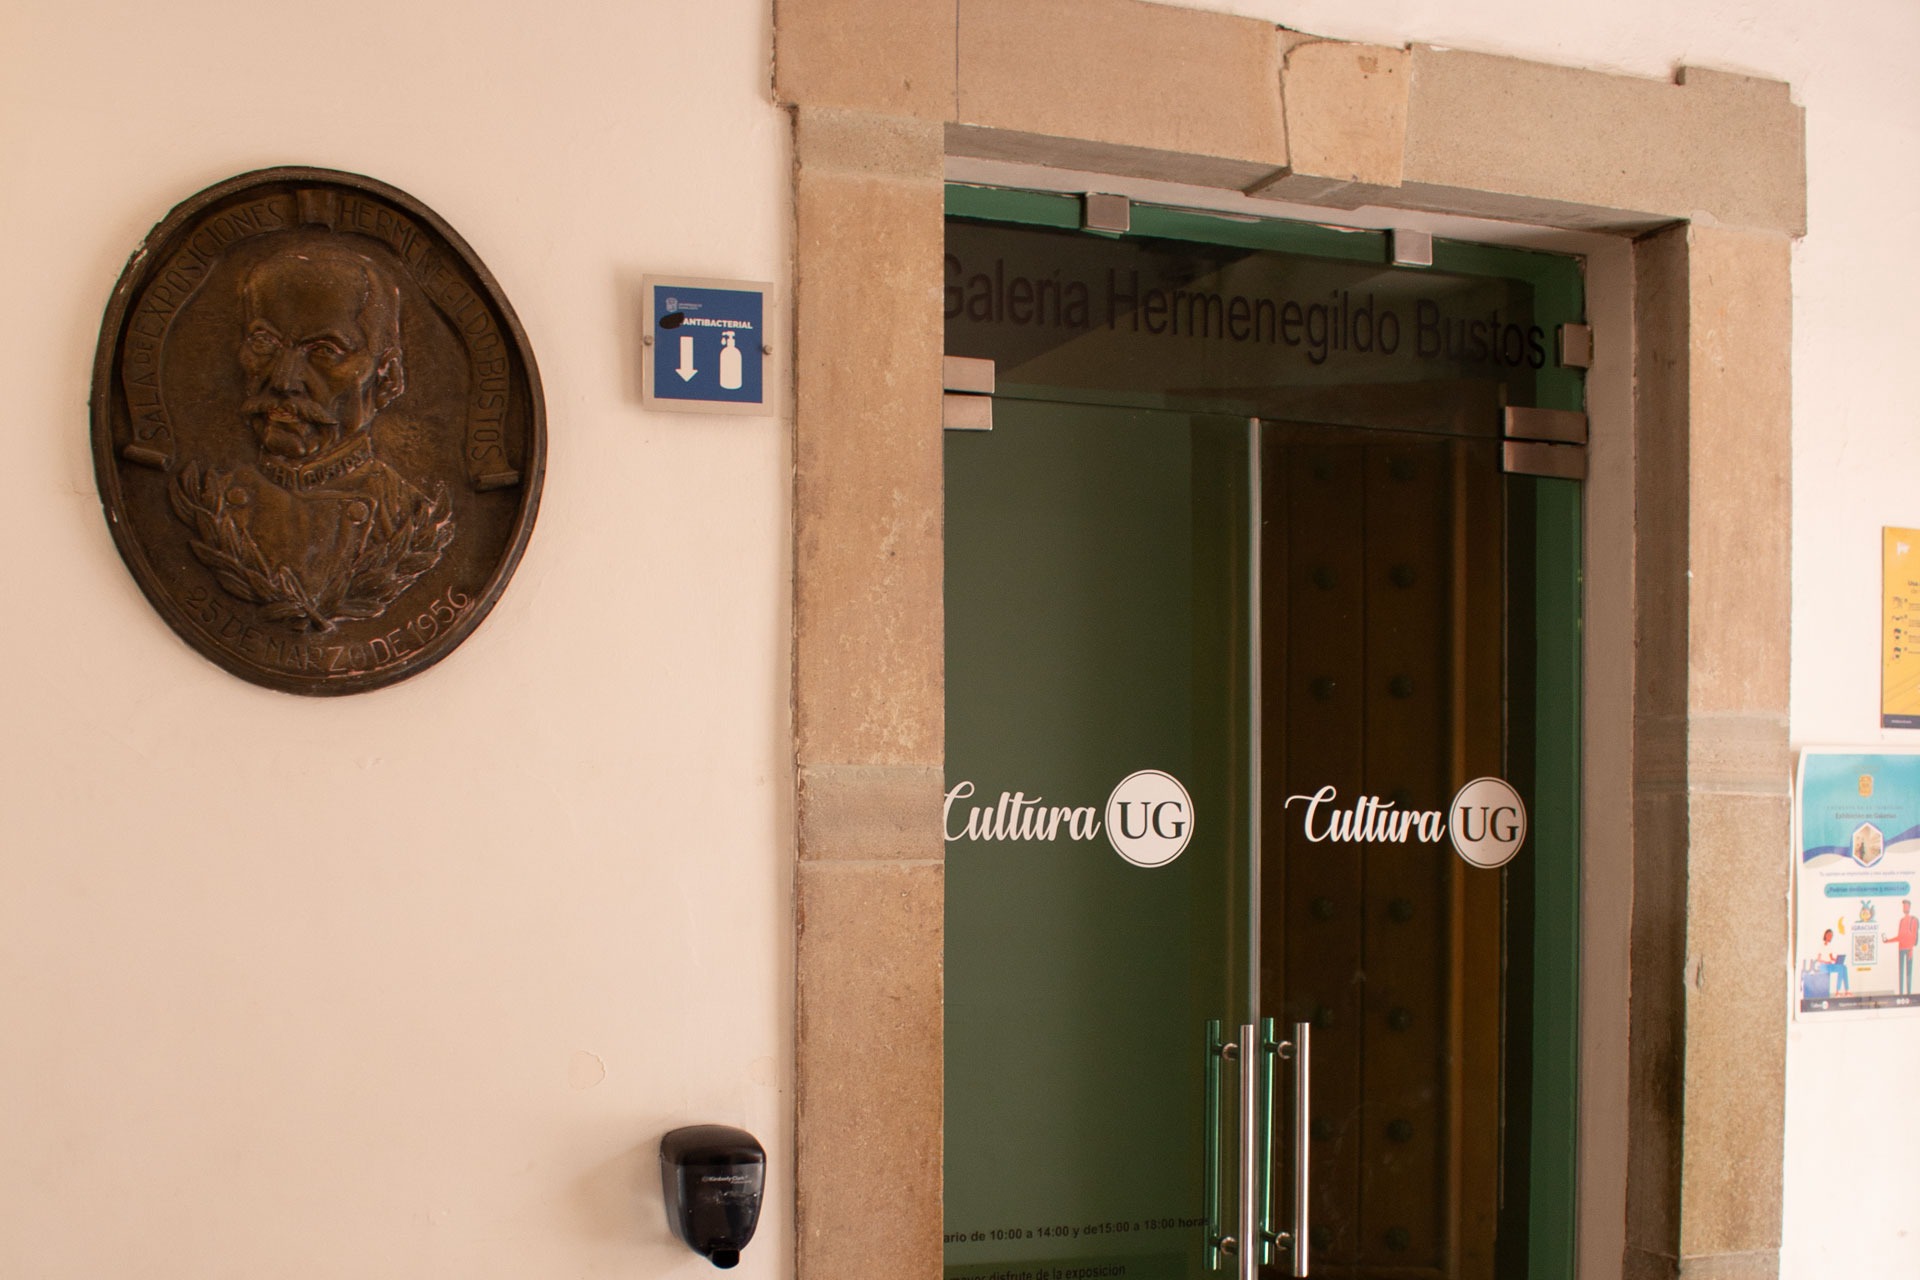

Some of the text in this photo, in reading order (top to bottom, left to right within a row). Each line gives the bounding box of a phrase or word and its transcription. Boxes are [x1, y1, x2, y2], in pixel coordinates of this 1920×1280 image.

[132, 200, 284, 442] SALA DE EXPOSICIONES
[339, 199, 507, 462] HERMENEGILDO BUSTOS
[683, 317, 753, 330] ANTIBACTERIAL
[1106, 267, 1401, 365] Hermenegildo
[1416, 297, 1546, 370] Bustos
[184, 585, 469, 673] 25 DE MARZO DE 1956
[943, 781, 1186, 842] Cultura UG
[1284, 785, 1520, 844] Cultura UG
[943, 1232, 967, 1244] ario
[971, 1230, 986, 1243] de
[990, 1229, 1022, 1241] 10:00
[1026, 1231, 1033, 1239] a
[1037, 1226, 1069, 1238] 14:00
[1073, 1227, 1080, 1238] y
[1133, 1223, 1140, 1232] a
[1144, 1218, 1175, 1230] 18:00
[988, 1267, 1032, 1280] disfrute
[1036, 1268, 1050, 1280] de
[1052, 1267, 1063, 1279] la
